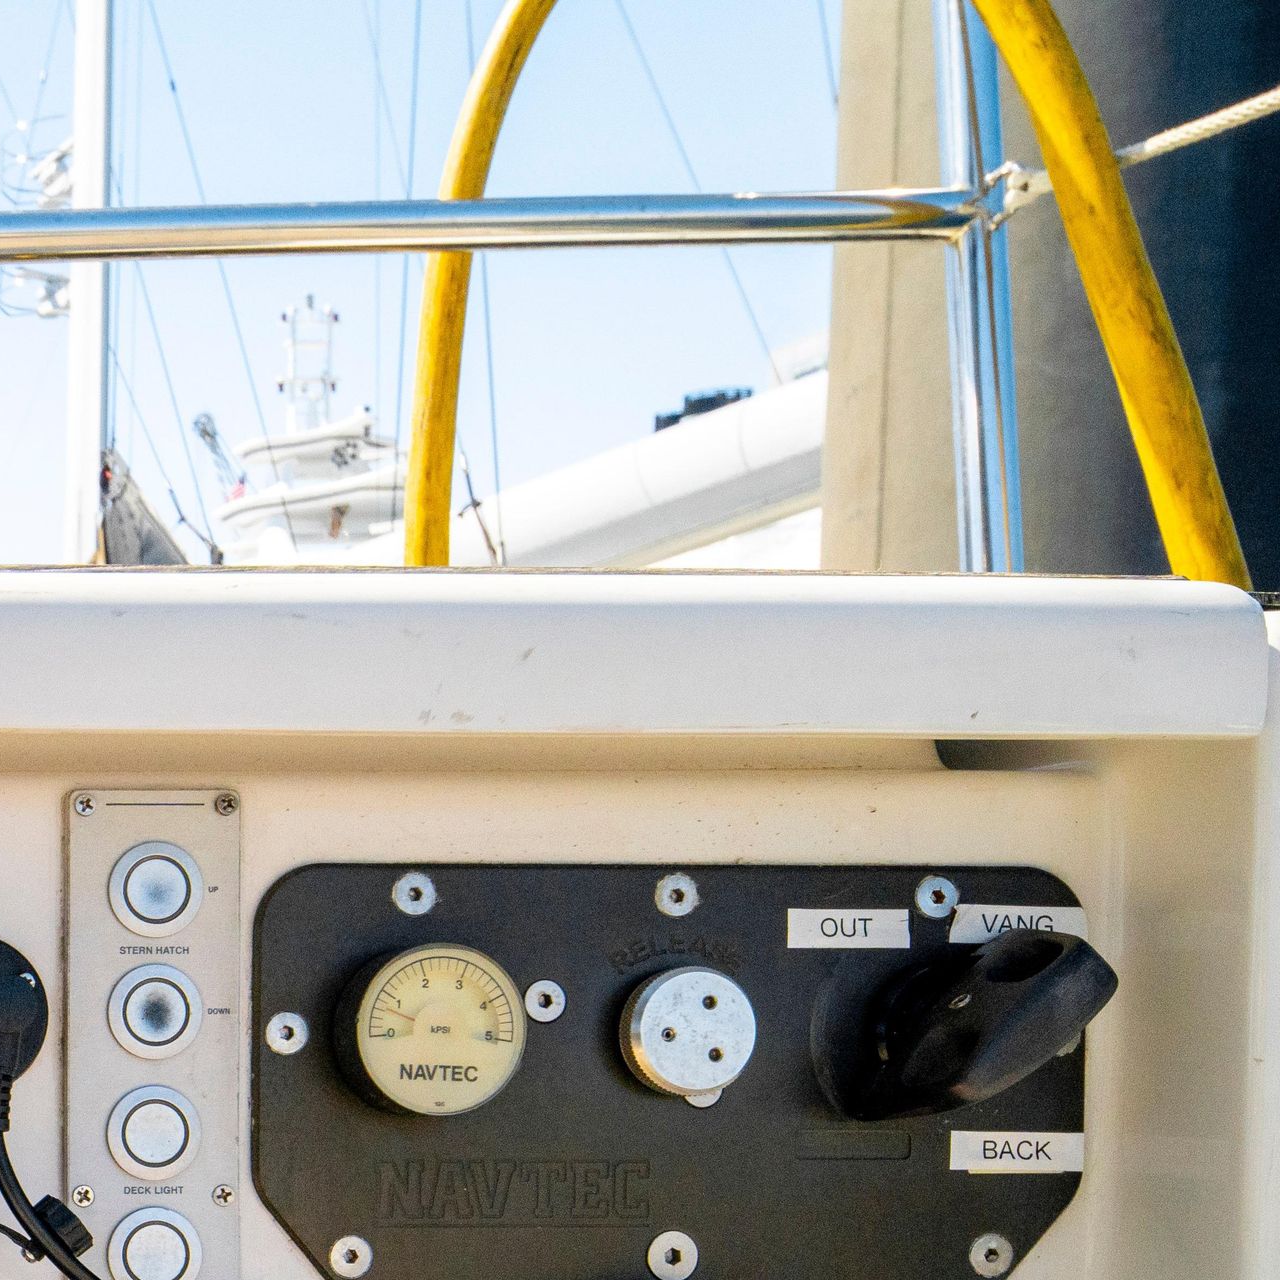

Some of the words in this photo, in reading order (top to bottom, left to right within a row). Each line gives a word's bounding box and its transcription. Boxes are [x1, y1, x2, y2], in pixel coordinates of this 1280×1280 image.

[820, 917, 873, 938] OUT
[982, 913, 1054, 933] VANG
[119, 946, 153, 955] STERN
[156, 946, 190, 955] HATCH
[422, 978, 429, 988] 2
[455, 979, 463, 989] 3
[396, 999, 401, 1008] 1
[480, 1001, 487, 1011] 4
[387, 1027, 395, 1037] 0
[485, 1031, 493, 1040] 5
[399, 1064, 478, 1082] NAVTEC
[982, 1140, 1052, 1161] BACK
[123, 1186, 151, 1195] DECK
[154, 1186, 184, 1195] LIGHT
[376, 1159, 651, 1219] NAVTEC
